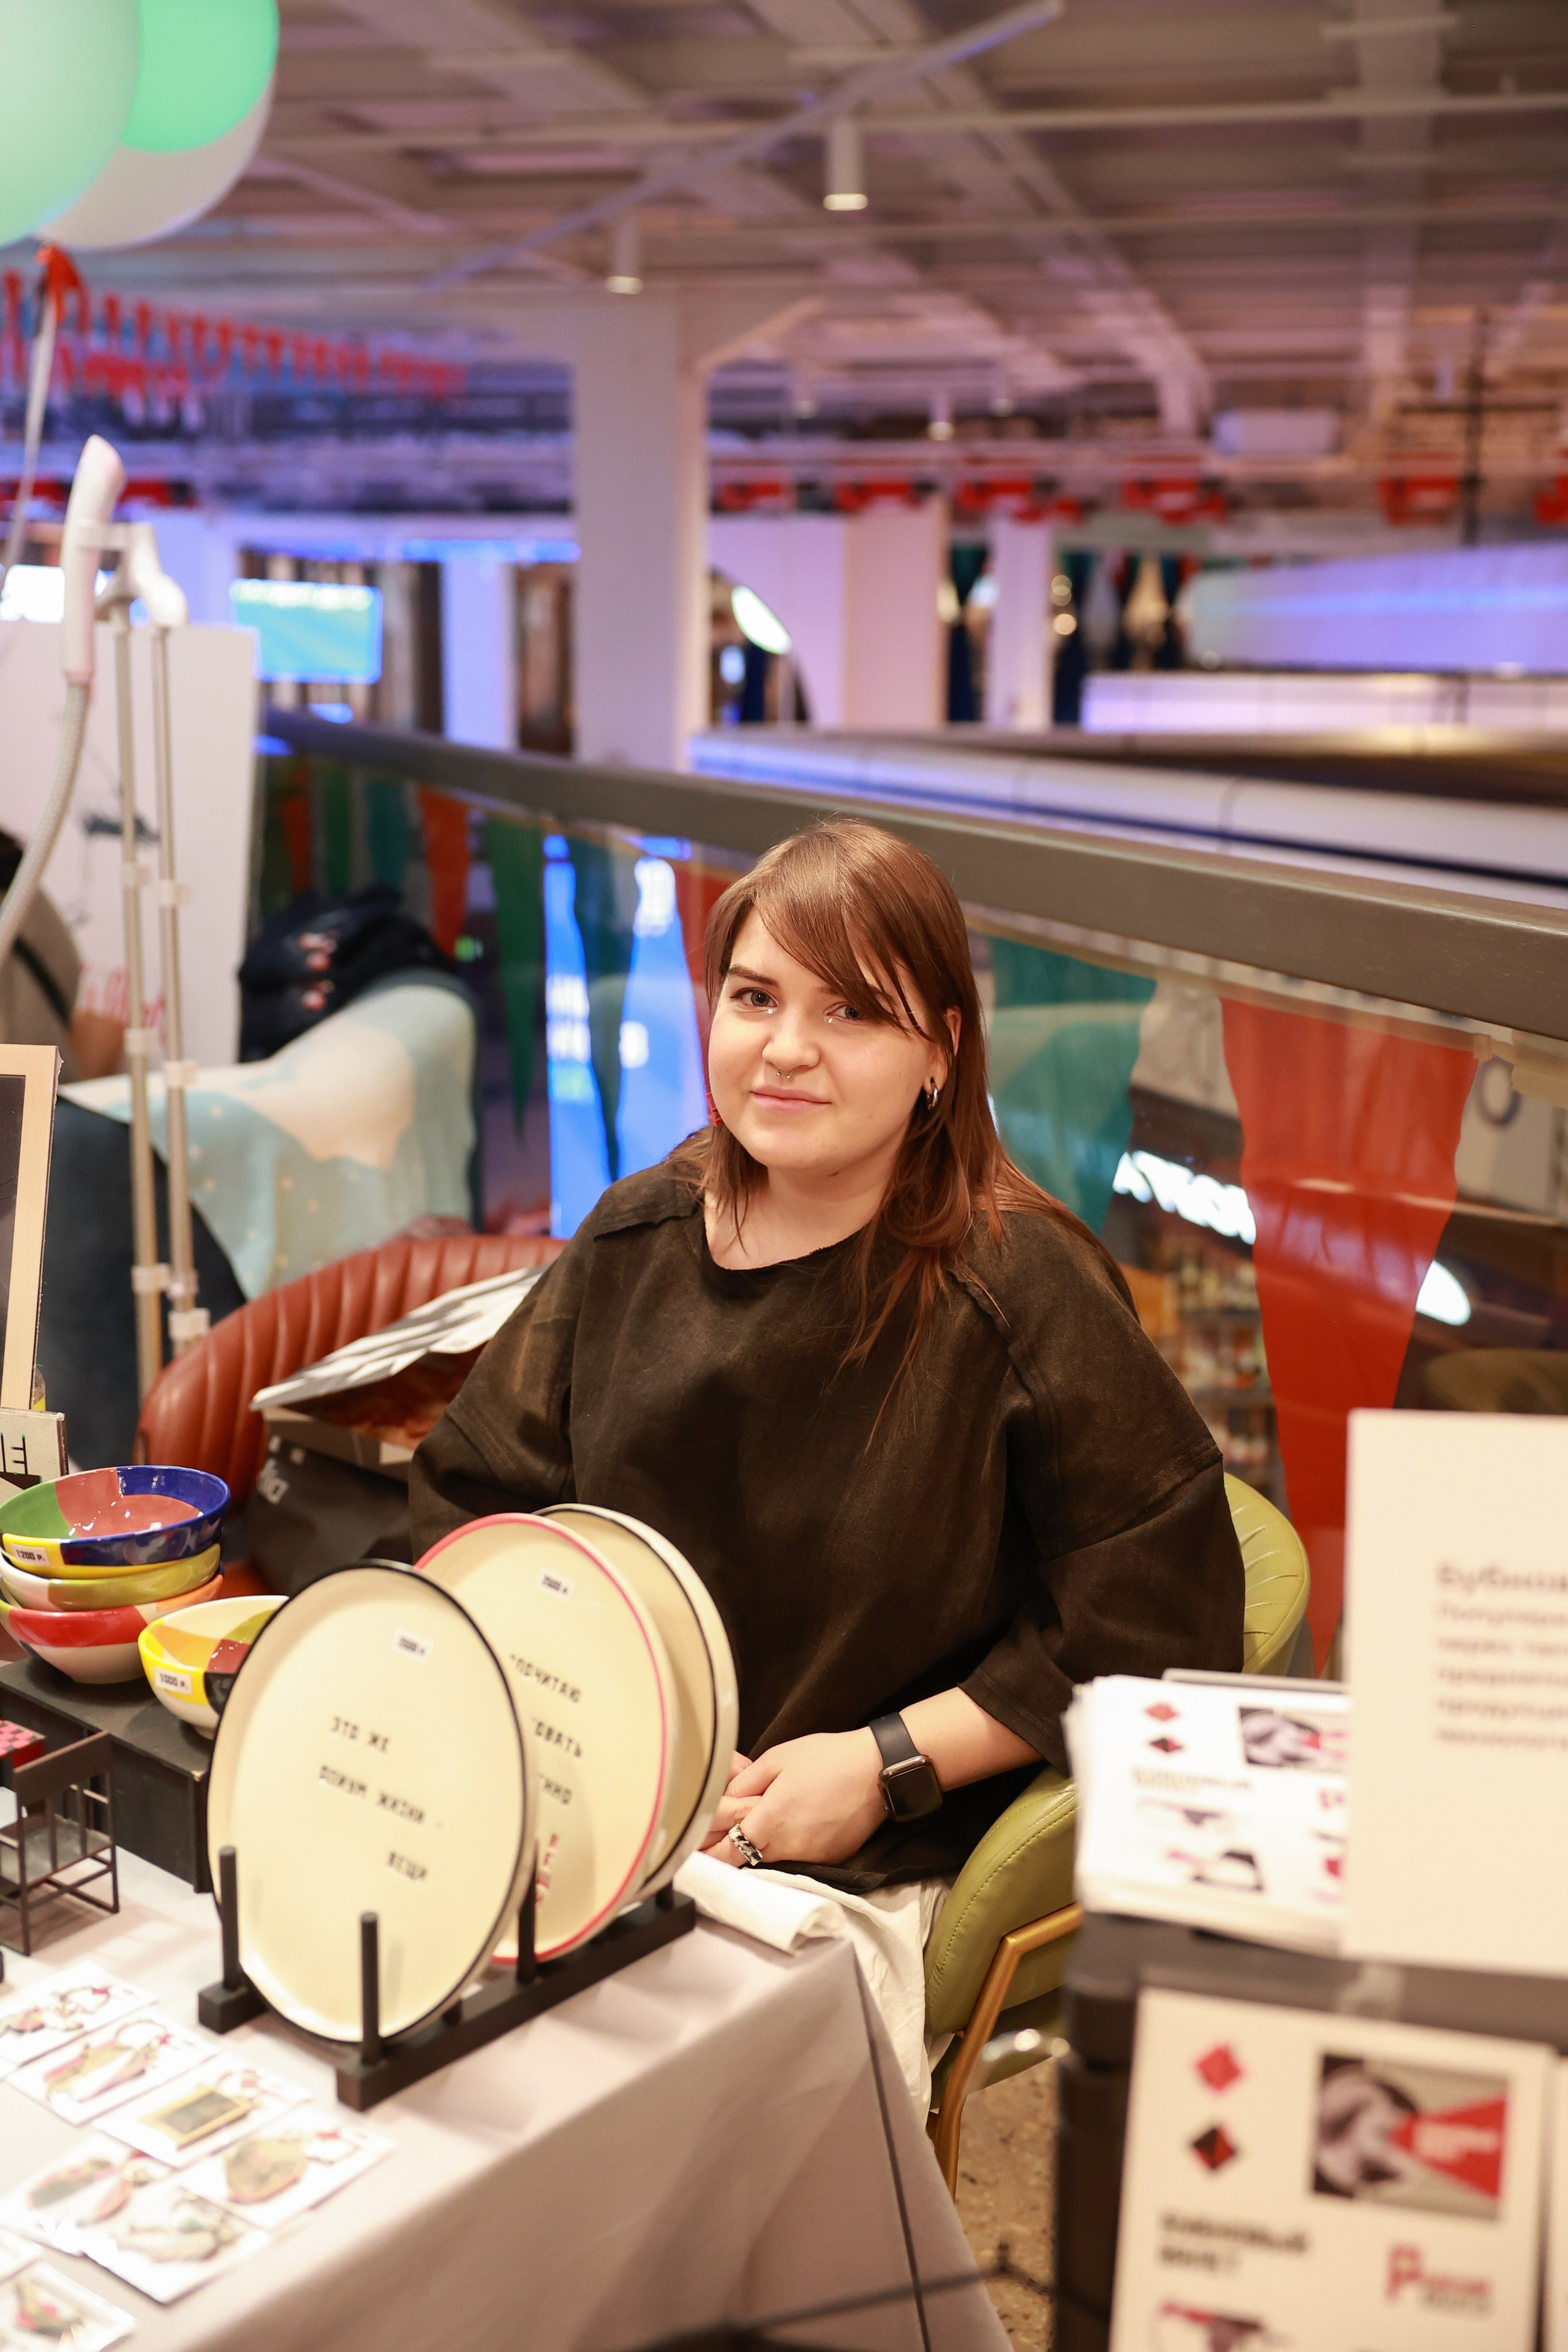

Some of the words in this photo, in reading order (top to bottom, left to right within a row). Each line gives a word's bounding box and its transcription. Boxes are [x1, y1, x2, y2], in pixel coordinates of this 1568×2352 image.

[16, 1549, 36, 1560] 1200
[330, 1716, 359, 1740] ЭТО
[368, 1732, 389, 1753] ЖЕ
[532, 1717, 582, 1758] ОВАТЬ
[538, 1773, 573, 1805] ННО
